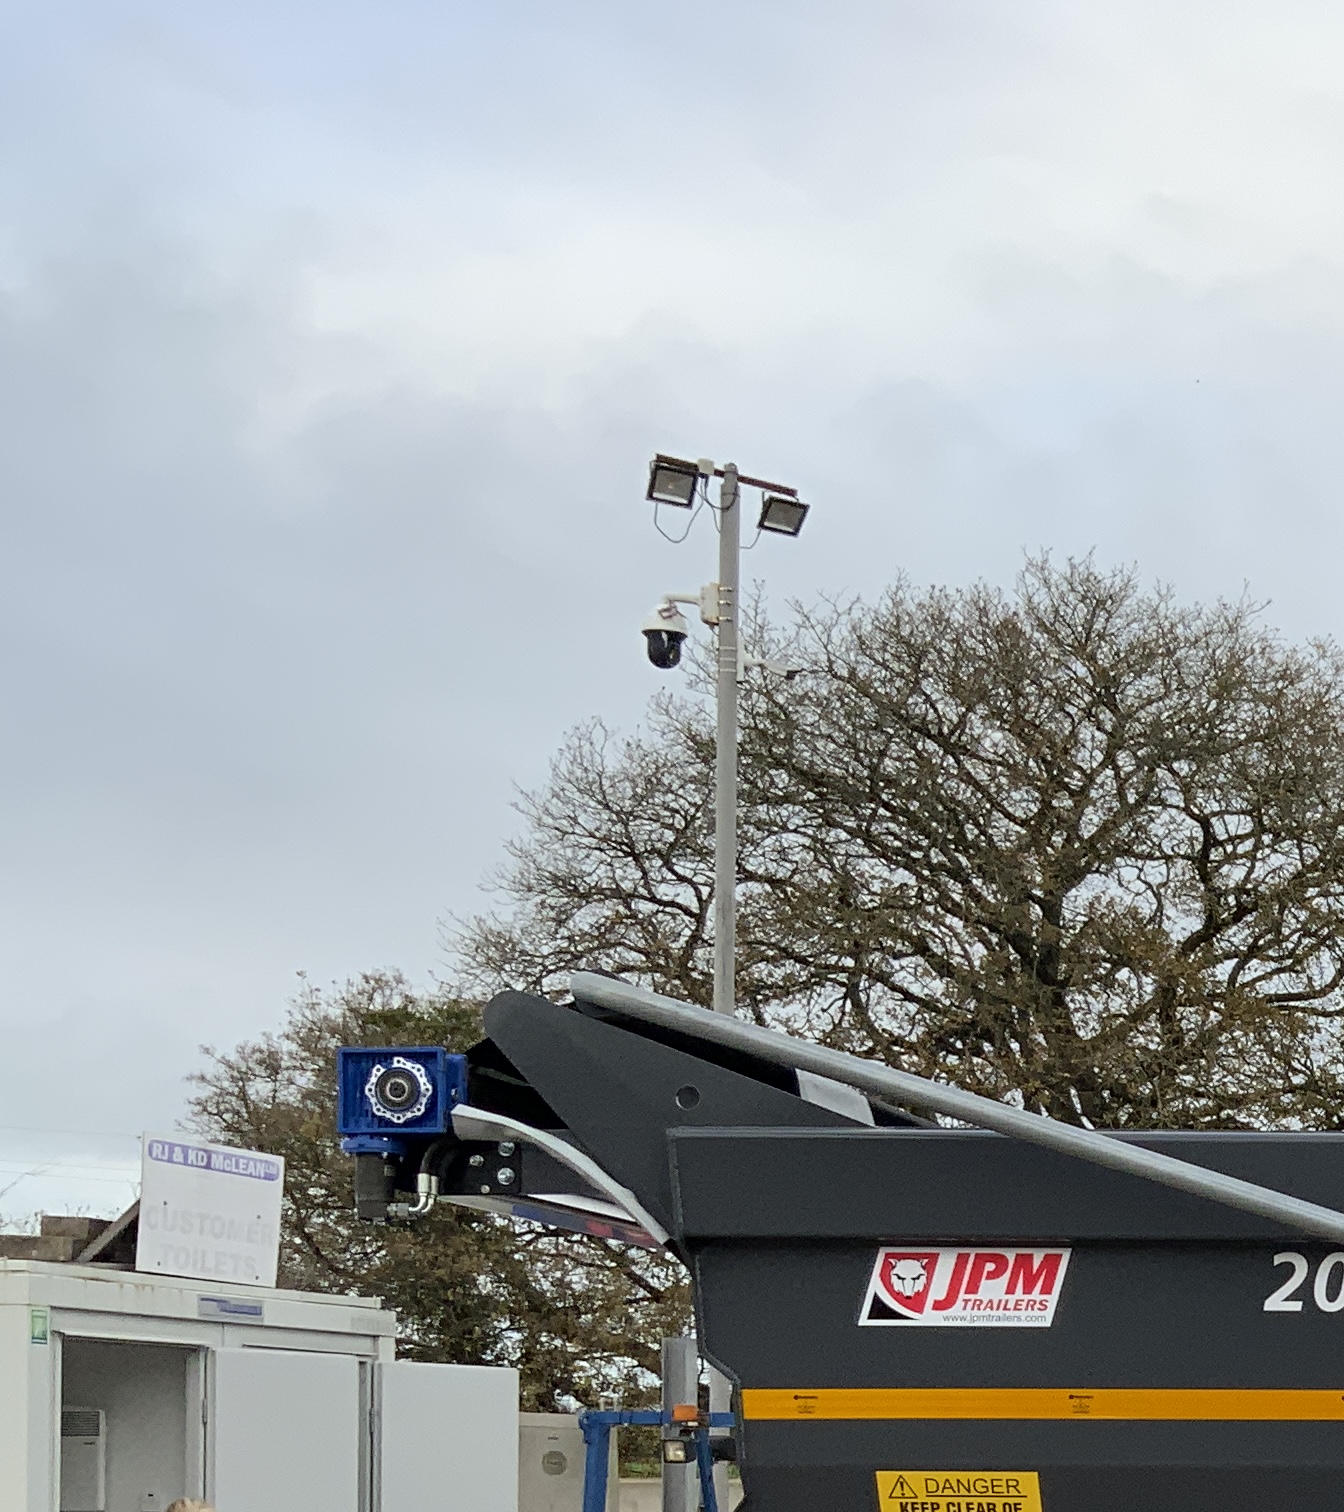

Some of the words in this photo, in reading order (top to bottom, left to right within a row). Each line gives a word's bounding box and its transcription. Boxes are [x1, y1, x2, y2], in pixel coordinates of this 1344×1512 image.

[152, 1142, 168, 1160] RJ
[172, 1146, 184, 1163] &
[187, 1148, 207, 1167] KD
[210, 1153, 265, 1177] McLEAN
[145, 1204, 273, 1246] CUSTOMER
[931, 1253, 1063, 1311] JPM
[961, 1299, 1049, 1312] TRAILERS
[942, 1313, 1047, 1324] www.jpmtrailers.com
[925, 1478, 1022, 1494] DANGER
